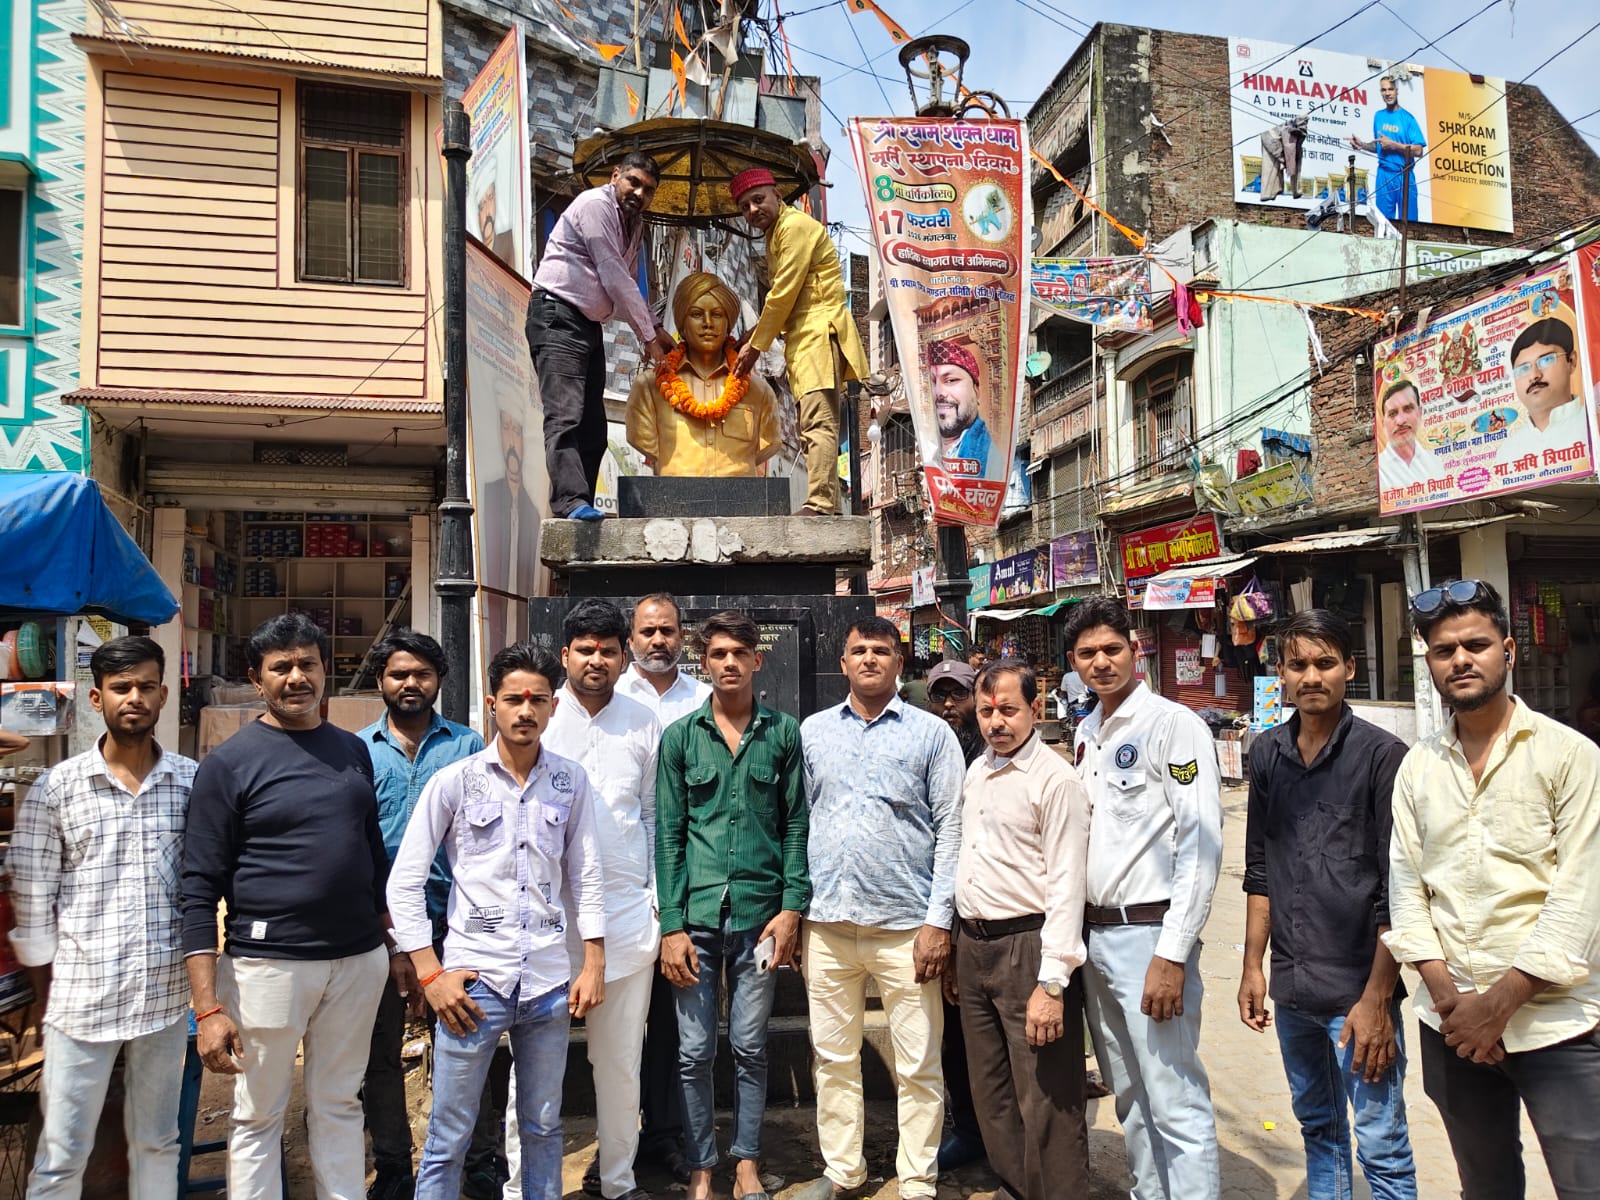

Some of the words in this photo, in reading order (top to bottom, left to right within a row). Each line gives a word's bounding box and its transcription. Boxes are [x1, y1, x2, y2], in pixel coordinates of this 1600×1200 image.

[1243, 72, 1368, 106] HIMALAYAN
[1253, 94, 1361, 118] ADHESIVES
[874, 120, 896, 143] श्री
[900, 124, 941, 147] श्याम
[943, 121, 983, 149] शक्ति
[986, 127, 1017, 150] धाम
[1439, 120, 1466, 135] SHRI
[1469, 124, 1496, 140] RAM
[870, 146, 906, 175] मूर्ति
[906, 152, 965, 175] स्थापना
[972, 149, 1012, 171] दिवस
[1319, 153, 1334, 162] वादा
[1452, 141, 1487, 157] HOME
[1435, 157, 1505, 178] COLLECTION
[875, 175, 895, 201] 8
[879, 210, 904, 235] 17
[906, 208, 951, 228] फरवरी
[1404, 351, 1427, 374] 35
[1420, 386, 1443, 404] भव्य
[1446, 376, 1473, 395] शोभा
[1476, 365, 1504, 384] यात्रा
[1543, 441, 1586, 466] त्रिपाठी
[965, 482, 1001, 508] चंचल
[1428, 474, 1454, 493] त्रिपाठी
[995, 560, 1015, 580] Amul
[1180, 769, 1190, 780] 73
